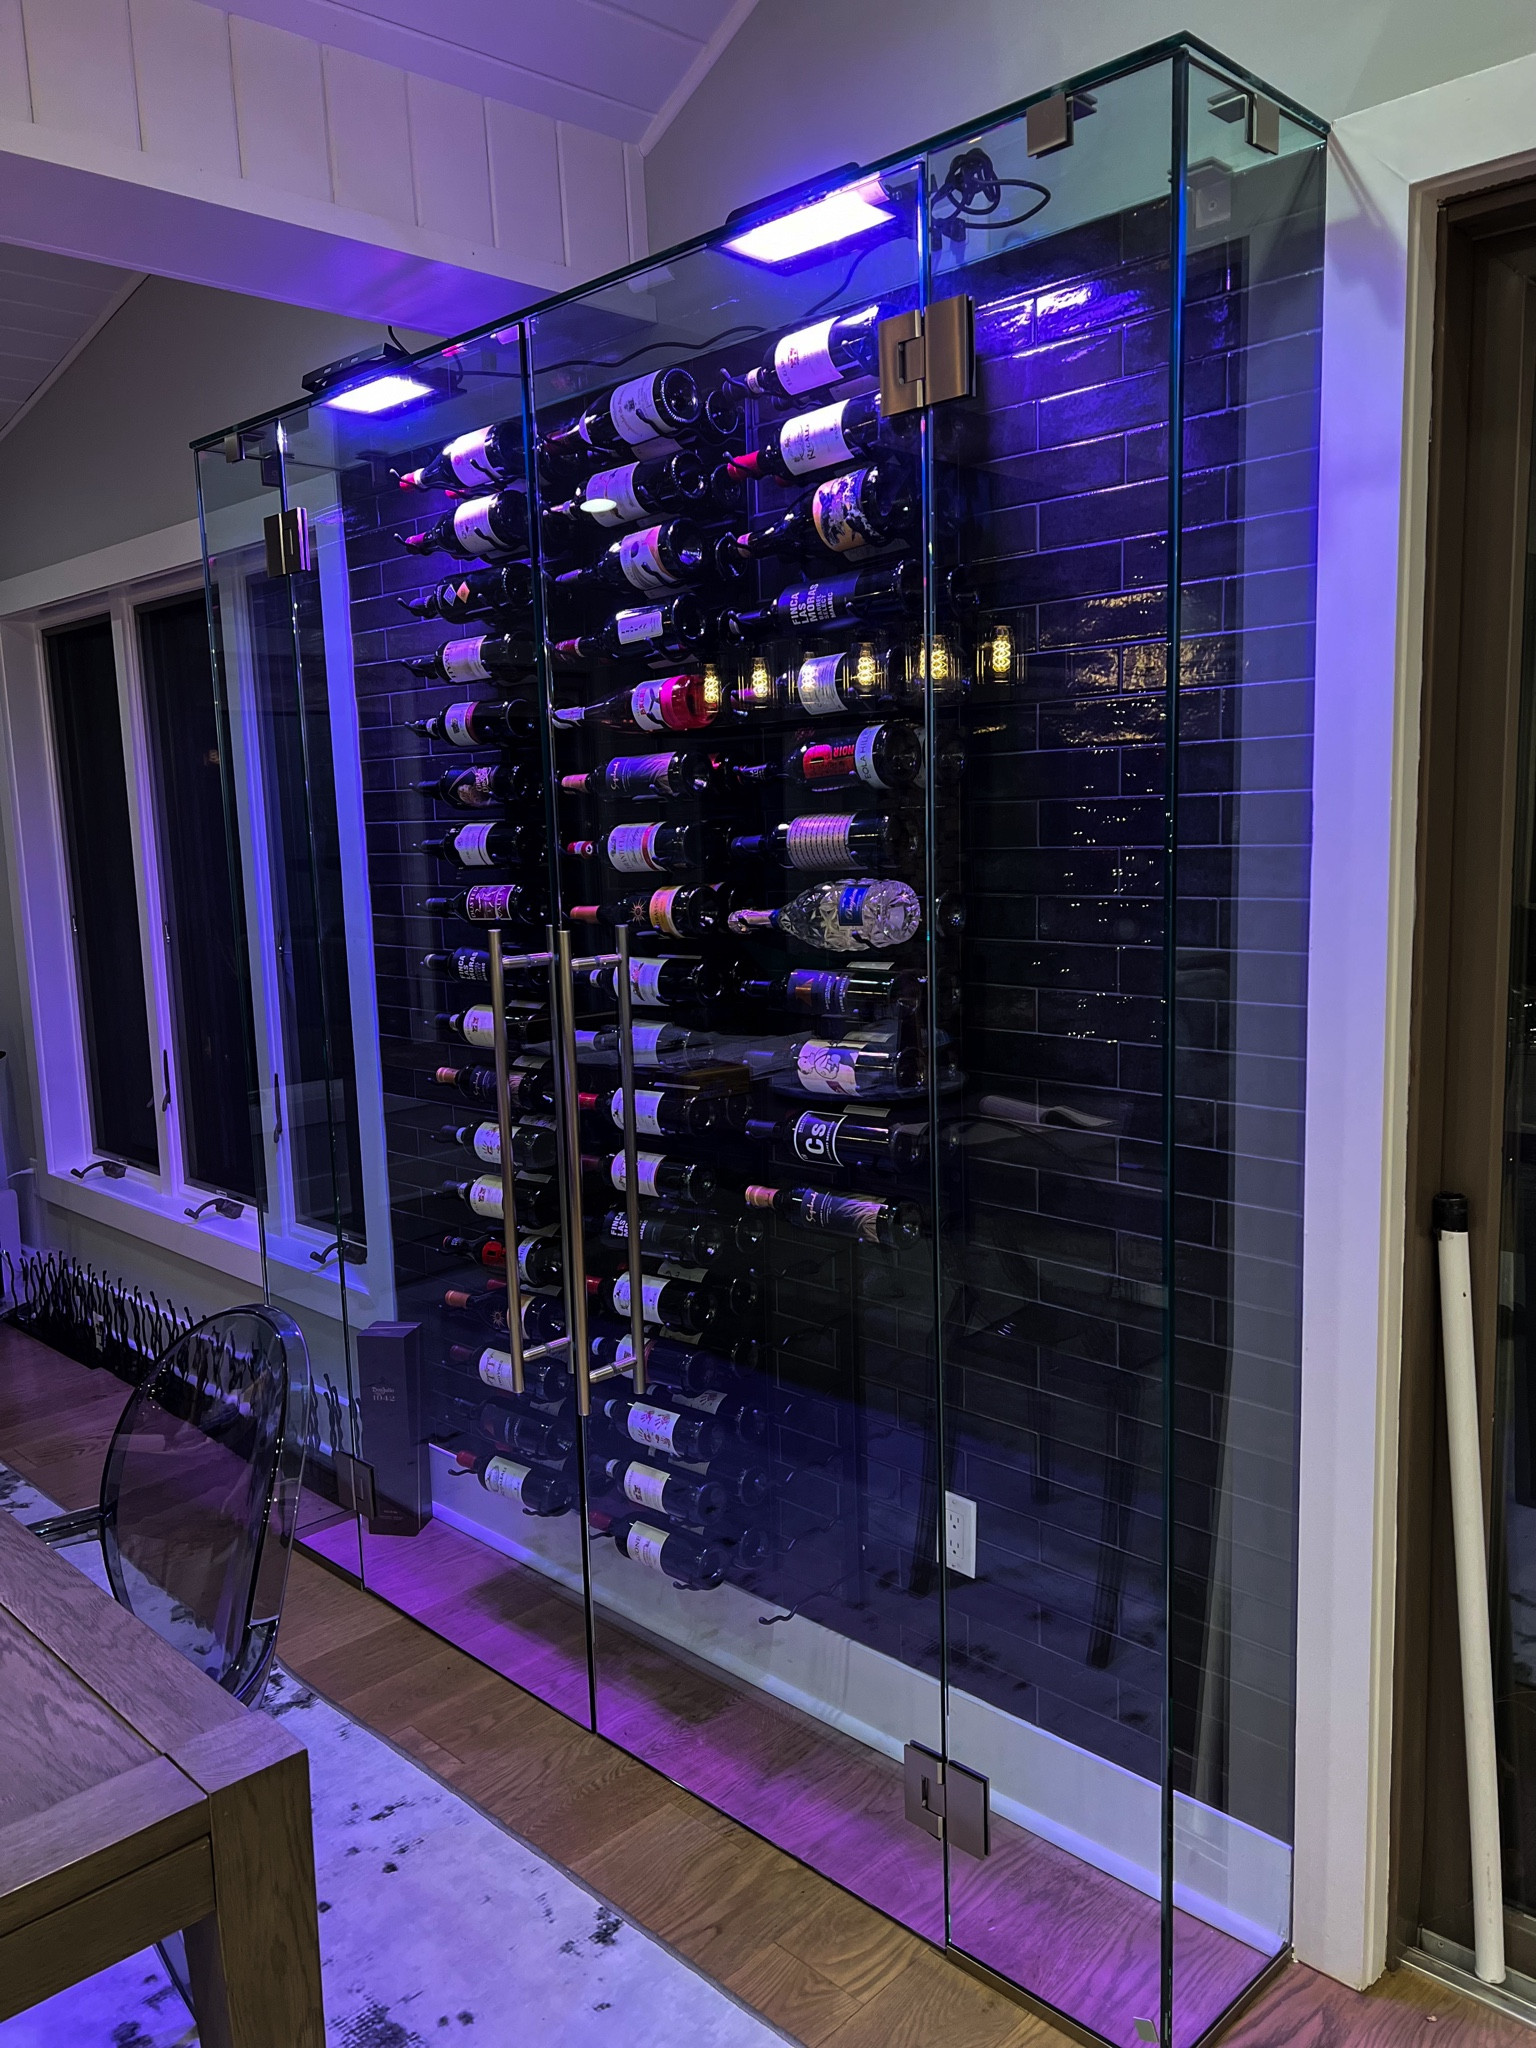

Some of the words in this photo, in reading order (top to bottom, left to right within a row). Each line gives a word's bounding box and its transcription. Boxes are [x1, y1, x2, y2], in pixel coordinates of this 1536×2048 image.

[790, 592, 801, 625] FINCA
[799, 602, 809, 624] LAS
[807, 583, 819, 622] MORAS
[827, 592, 837, 618] MALBEC
[833, 744, 855, 757] NOIR
[858, 755, 872, 779] EOLA
[458, 955, 466, 979] FINCA
[463, 964, 471, 980] LAS
[468, 951, 479, 981] MORAS
[805, 1124, 827, 1155] Cs
[610, 1211, 625, 1236] FINCA
[617, 1219, 627, 1237] LAS
